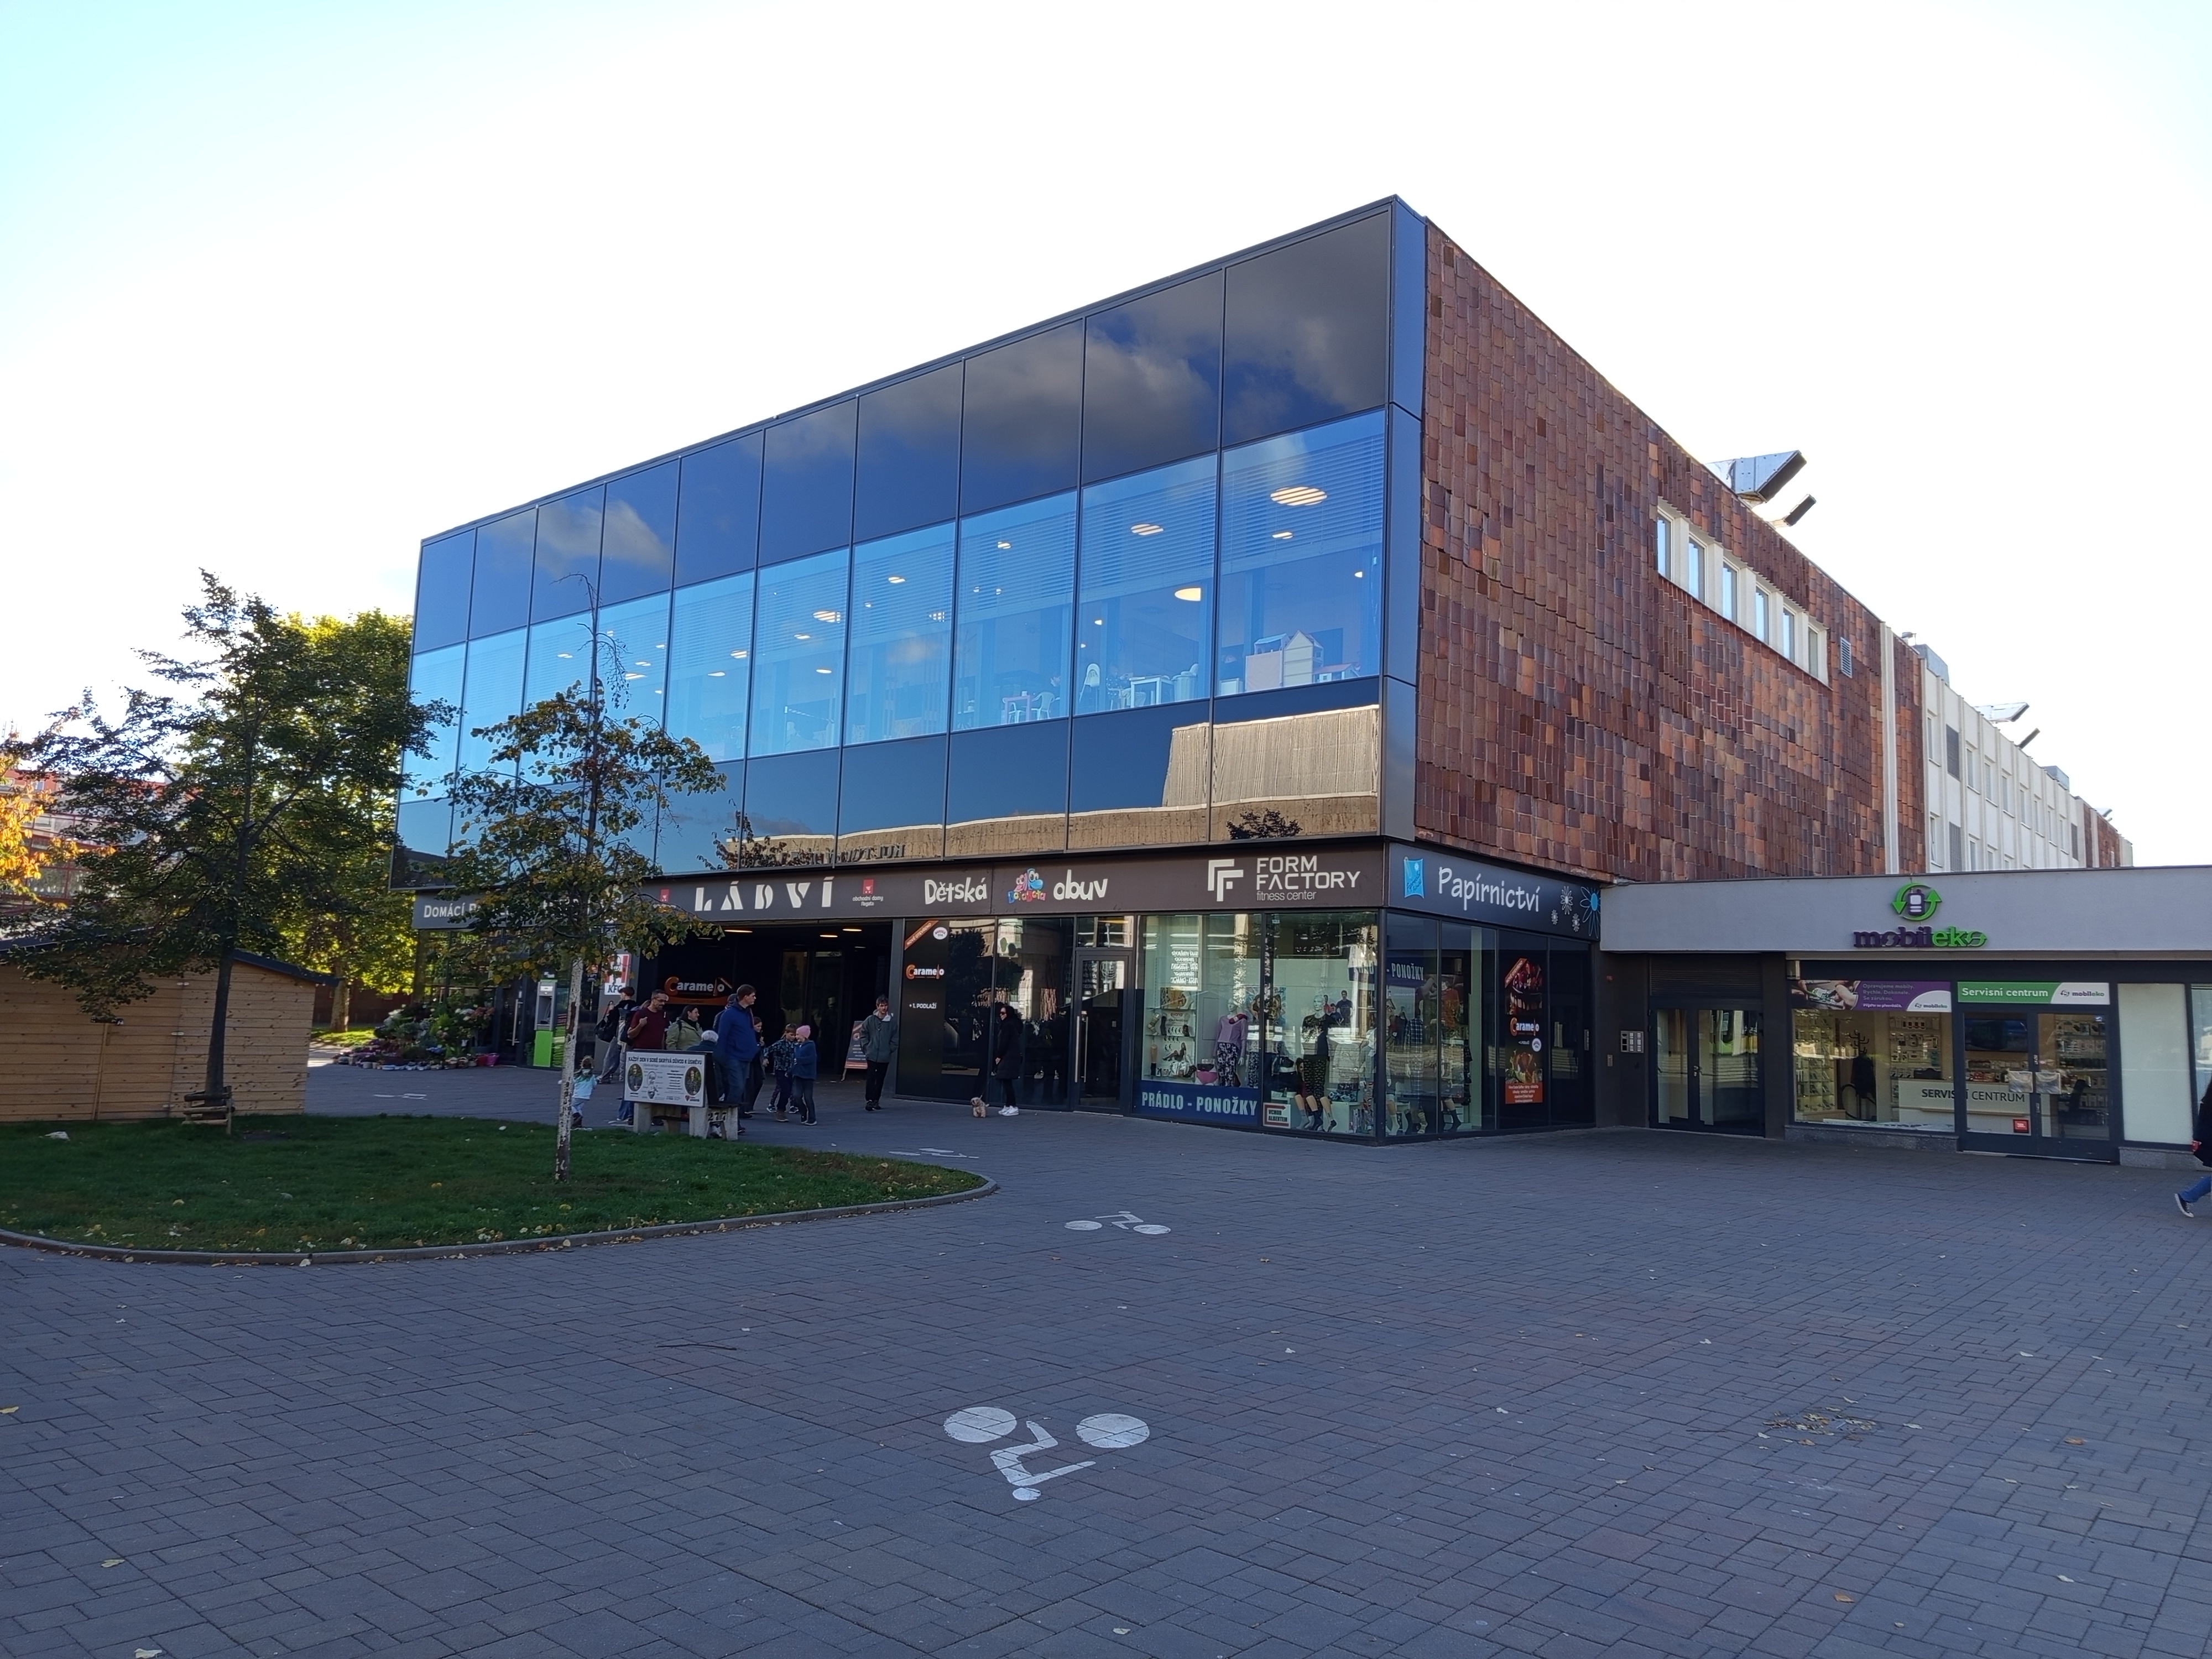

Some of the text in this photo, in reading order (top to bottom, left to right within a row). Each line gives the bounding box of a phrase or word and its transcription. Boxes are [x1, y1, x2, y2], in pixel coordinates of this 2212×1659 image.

[1256, 855, 1317, 873] FORM
[924, 869, 1108, 905] Dětská obuv
[1256, 871, 1361, 891] FACTORY
[1438, 866, 1541, 913] Papírnictví
[694, 876, 835, 912] LÁDVÍ
[1256, 890, 1317, 901] fitness center
[423, 902, 465, 919] DOMÁCÍ
[1853, 926, 1987, 948] mobileko
[906, 964, 945, 980] Caramelo
[1391, 962, 1424, 981] PONOŽKY
[664, 976, 725, 997] Caramelo
[1961, 988, 2049, 997] Servisní centrum
[1510, 1016, 1540, 1036] Caramelo
[1141, 1090, 1183, 1111] PRÁDLO
[1196, 1095, 1258, 1117] PONOŽKY
[1922, 1088, 2025, 1103] SERVISÍ CENTRUM
[707, 1112, 727, 1121] 277
